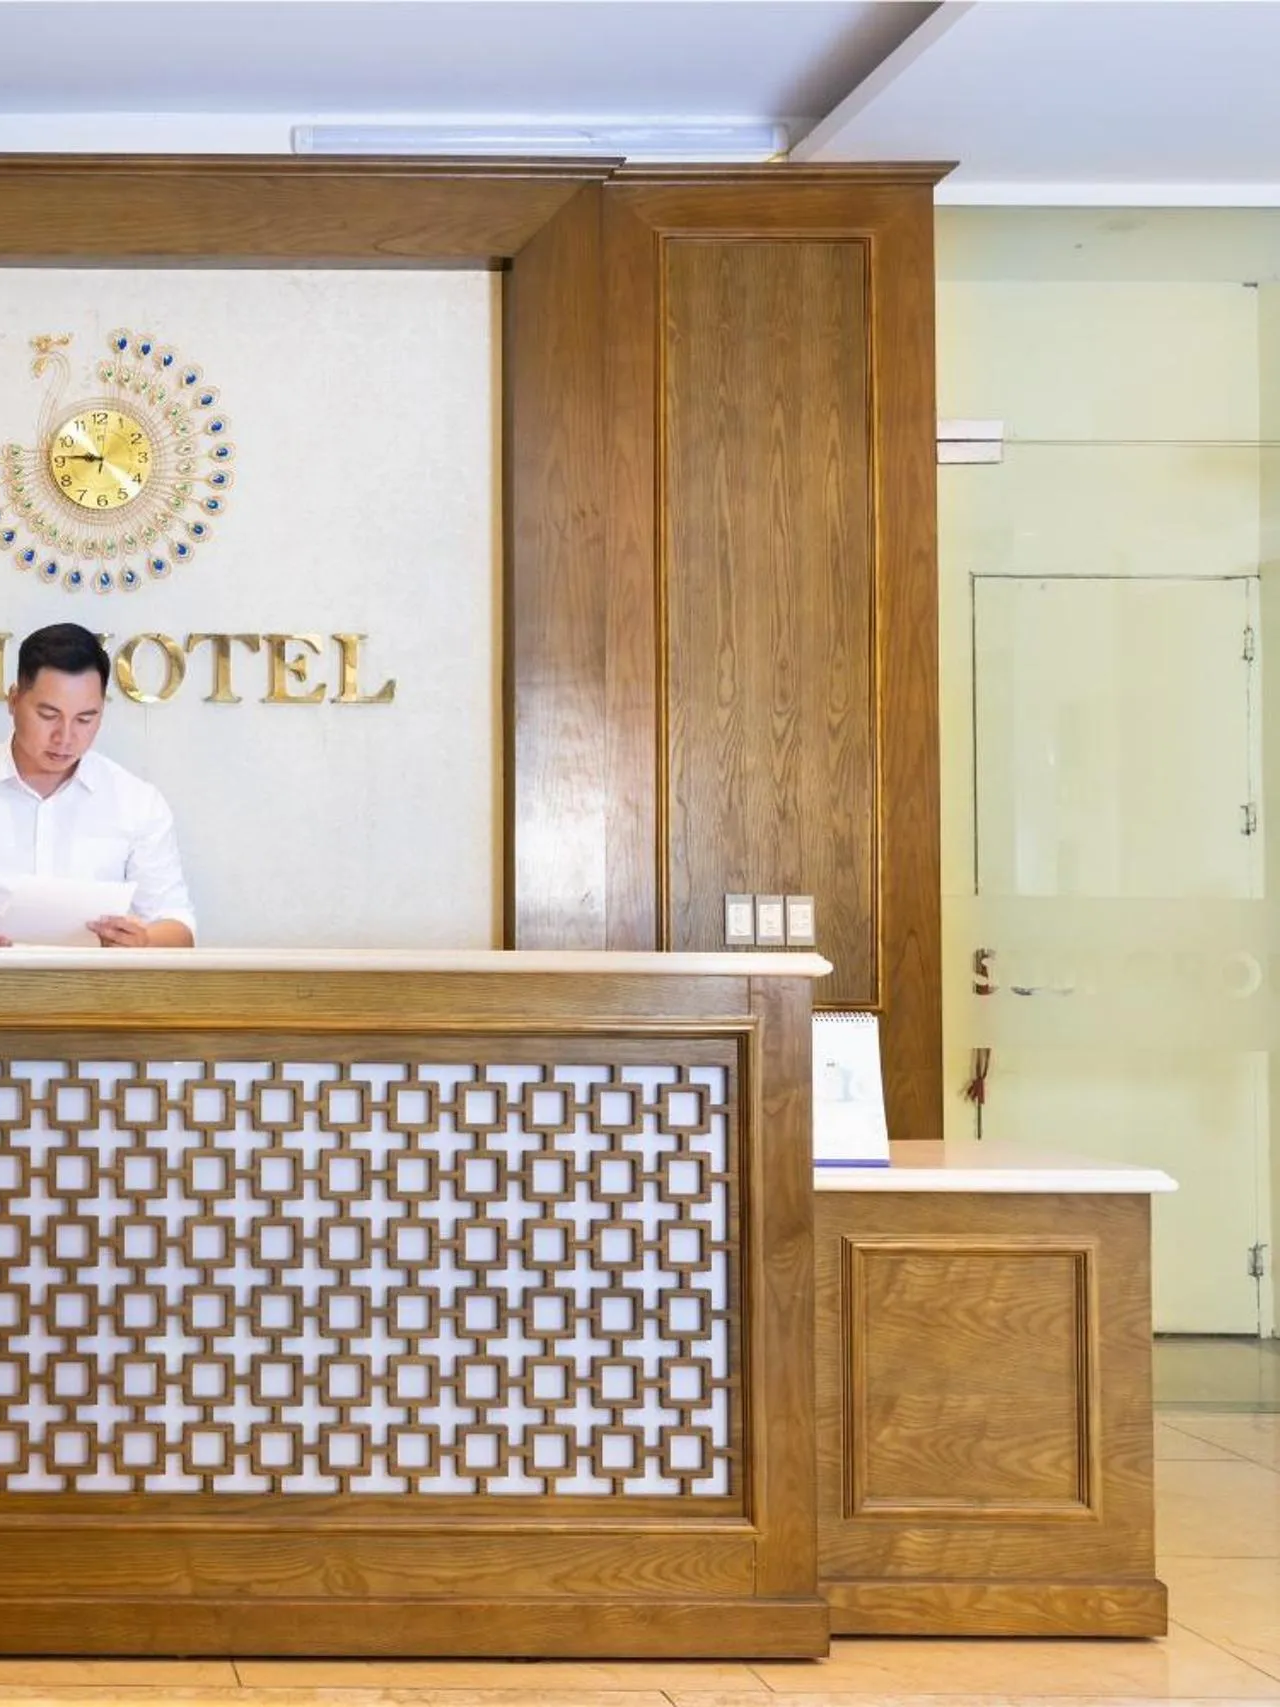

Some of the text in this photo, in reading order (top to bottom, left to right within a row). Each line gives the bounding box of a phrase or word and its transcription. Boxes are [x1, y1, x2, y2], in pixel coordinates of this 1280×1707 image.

[92, 412, 109, 424] 12
[74, 420, 86, 431] 11
[59, 435, 74, 448] 10
[131, 433, 142, 445] 2
[54, 456, 66, 468] 9
[138, 451, 148, 463] 3
[61, 474, 72, 487] 8
[131, 473, 142, 484] 4
[77, 489, 87, 501] 7
[117, 488, 128, 500] 5
[97, 495, 108, 507] 6
[94, 632, 397, 704] OTEL
